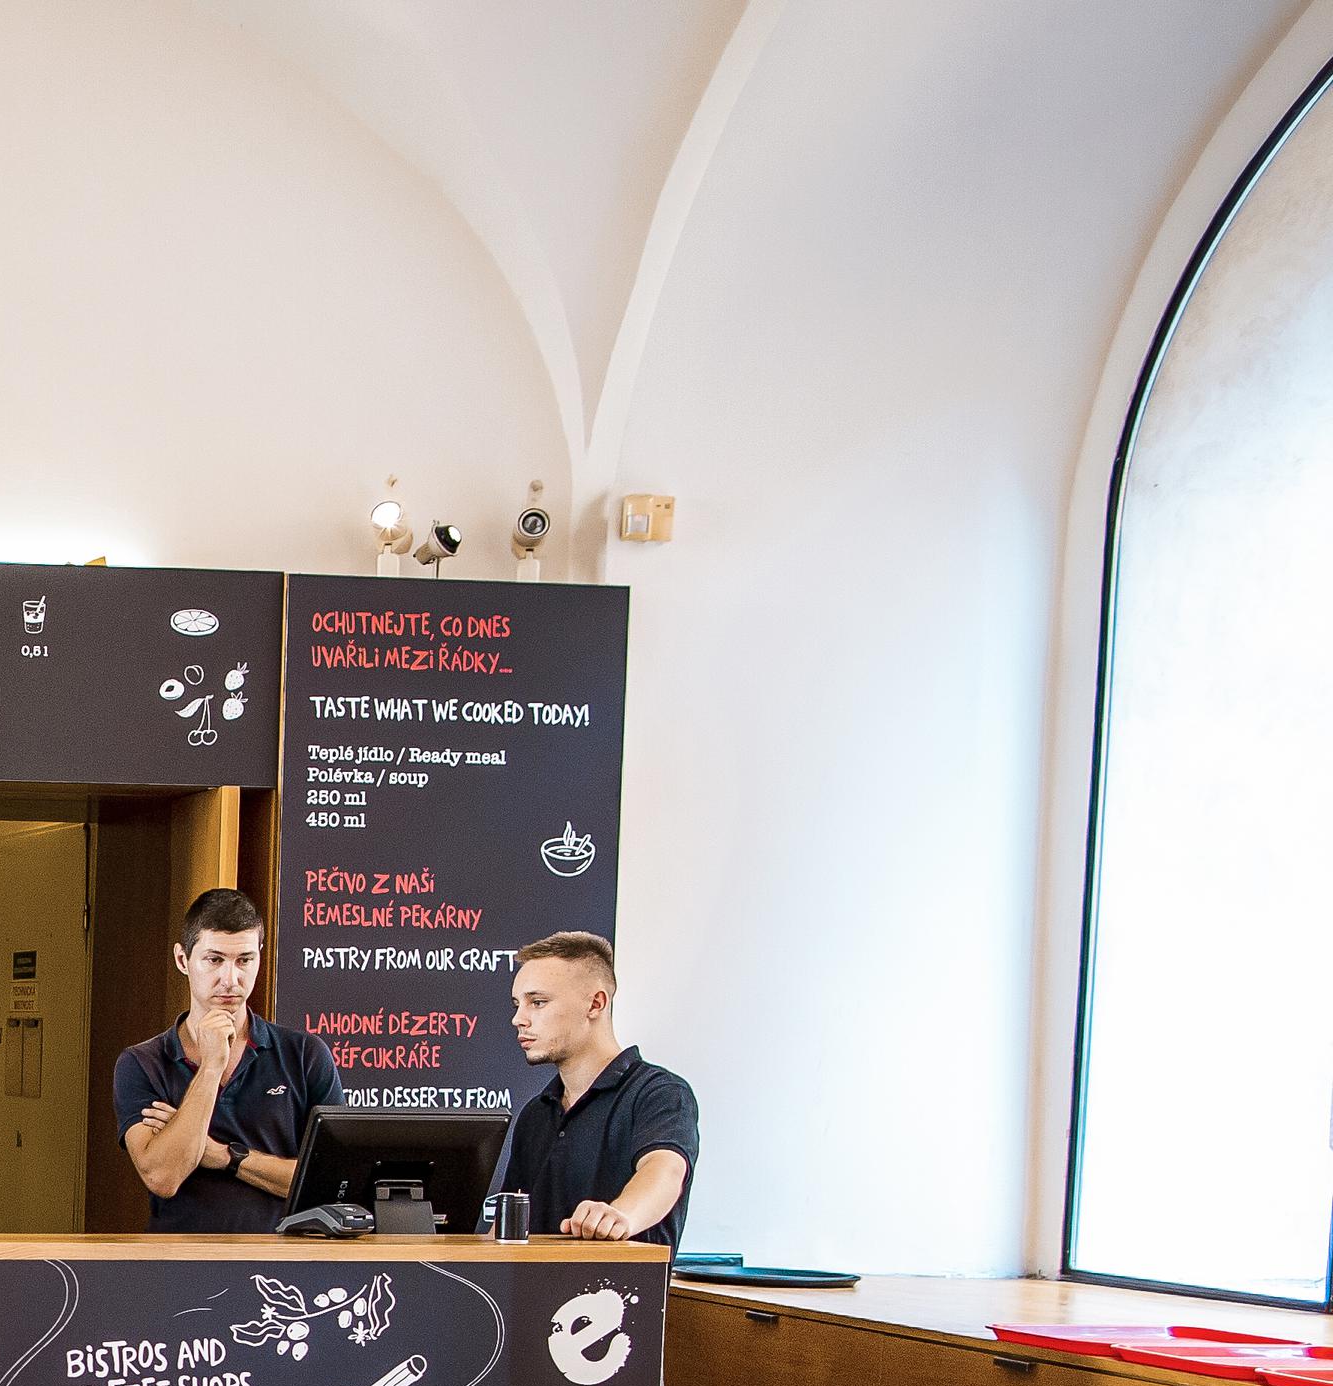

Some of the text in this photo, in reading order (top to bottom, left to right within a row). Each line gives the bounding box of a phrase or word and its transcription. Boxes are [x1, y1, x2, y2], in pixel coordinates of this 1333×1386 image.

[313, 611, 510, 640] OCHUTNEJTE, CO DNES
[310, 696, 589, 727] TASTE WHAT WE COOKED TODAY!
[308, 745, 506, 766] Teplé jídlo Ready meal
[307, 768, 428, 787] Polévka soup
[307, 790, 366, 805] 250 ml
[306, 812, 366, 827] 450 ml
[372, 874, 389, 894] Z
[304, 898, 481, 930] ŘEMESLNÉ PEKÁRNY
[303, 947, 518, 972] PASTRY FROM OUR CRAFT
[306, 1008, 477, 1037] LAHODNÉ DEZERTY
[383, 1087, 462, 1108] DESSERTS
[466, 1087, 511, 1109] FROM
[178, 1338, 226, 1369] AND
